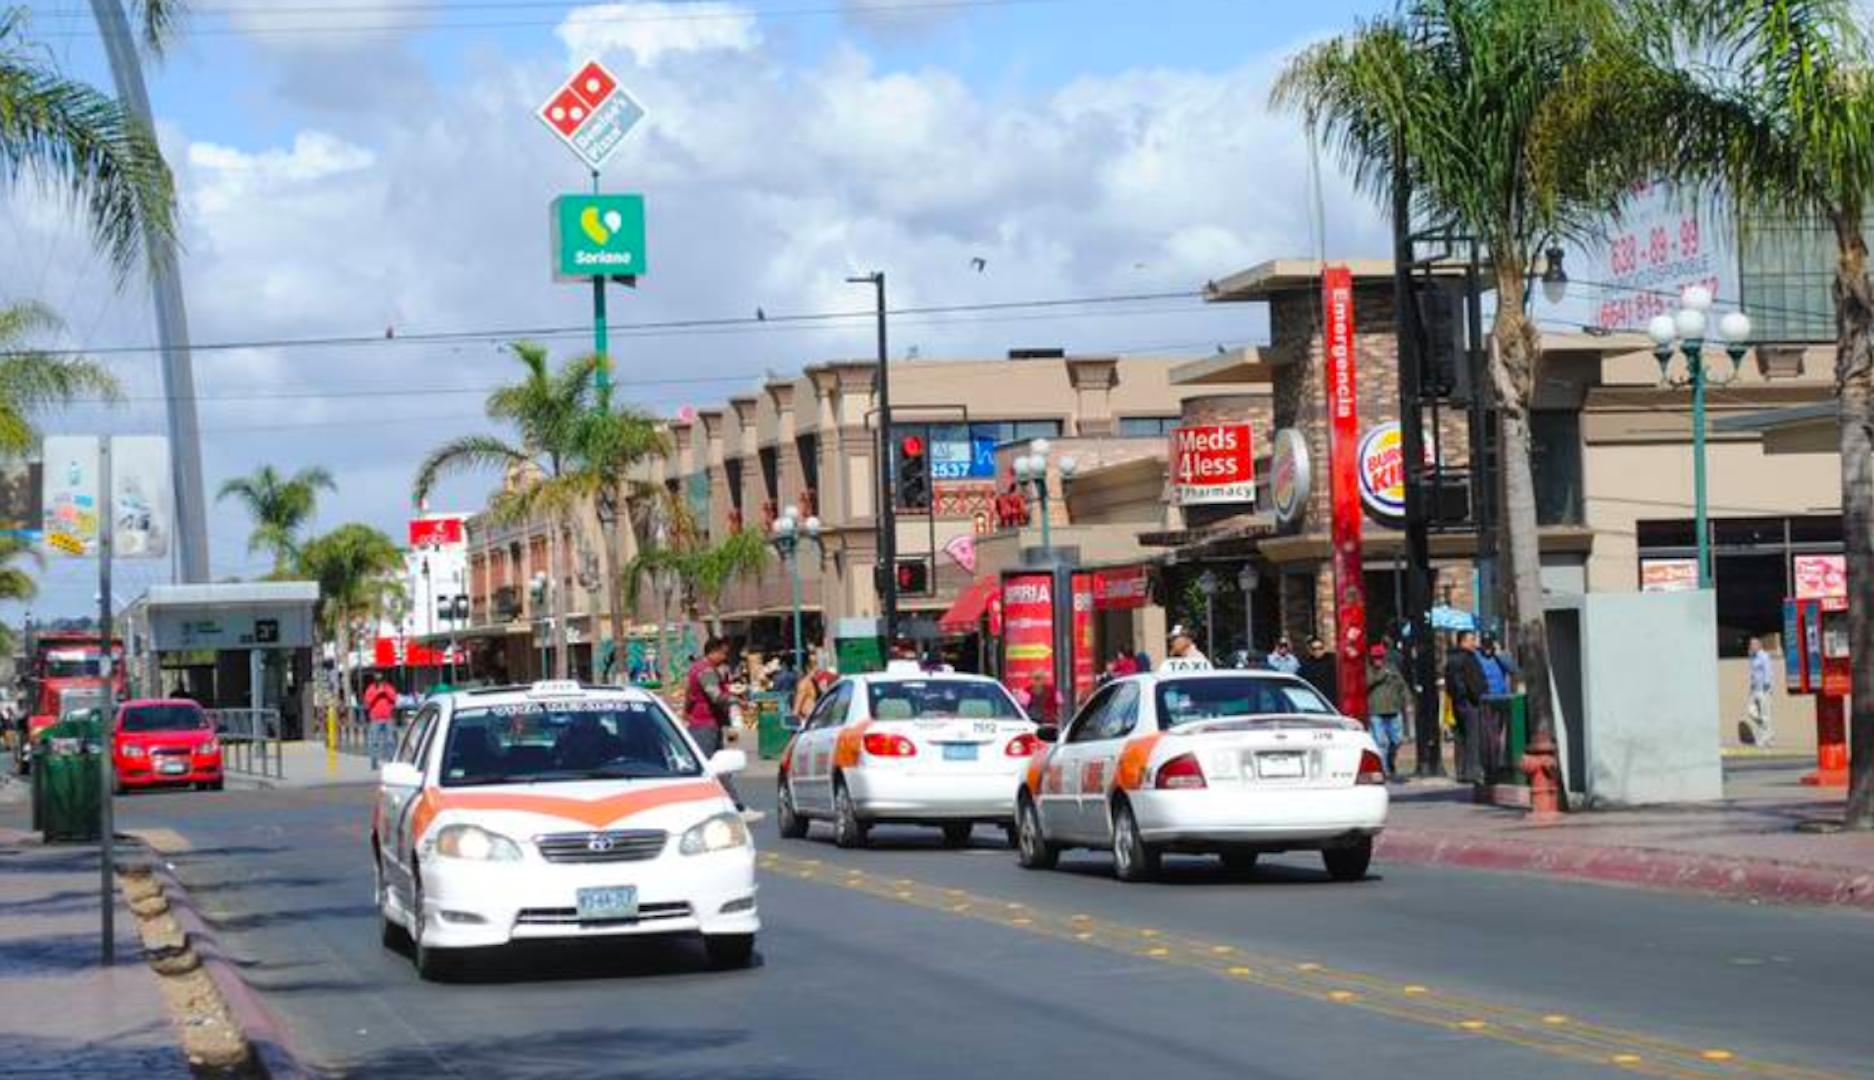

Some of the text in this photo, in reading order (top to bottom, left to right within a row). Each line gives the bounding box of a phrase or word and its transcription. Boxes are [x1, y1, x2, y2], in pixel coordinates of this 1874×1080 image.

[1333, 287, 1350, 418] Emergencia
[1179, 428, 1237, 452] Meds
[1170, 661, 1208, 671] TAXI
